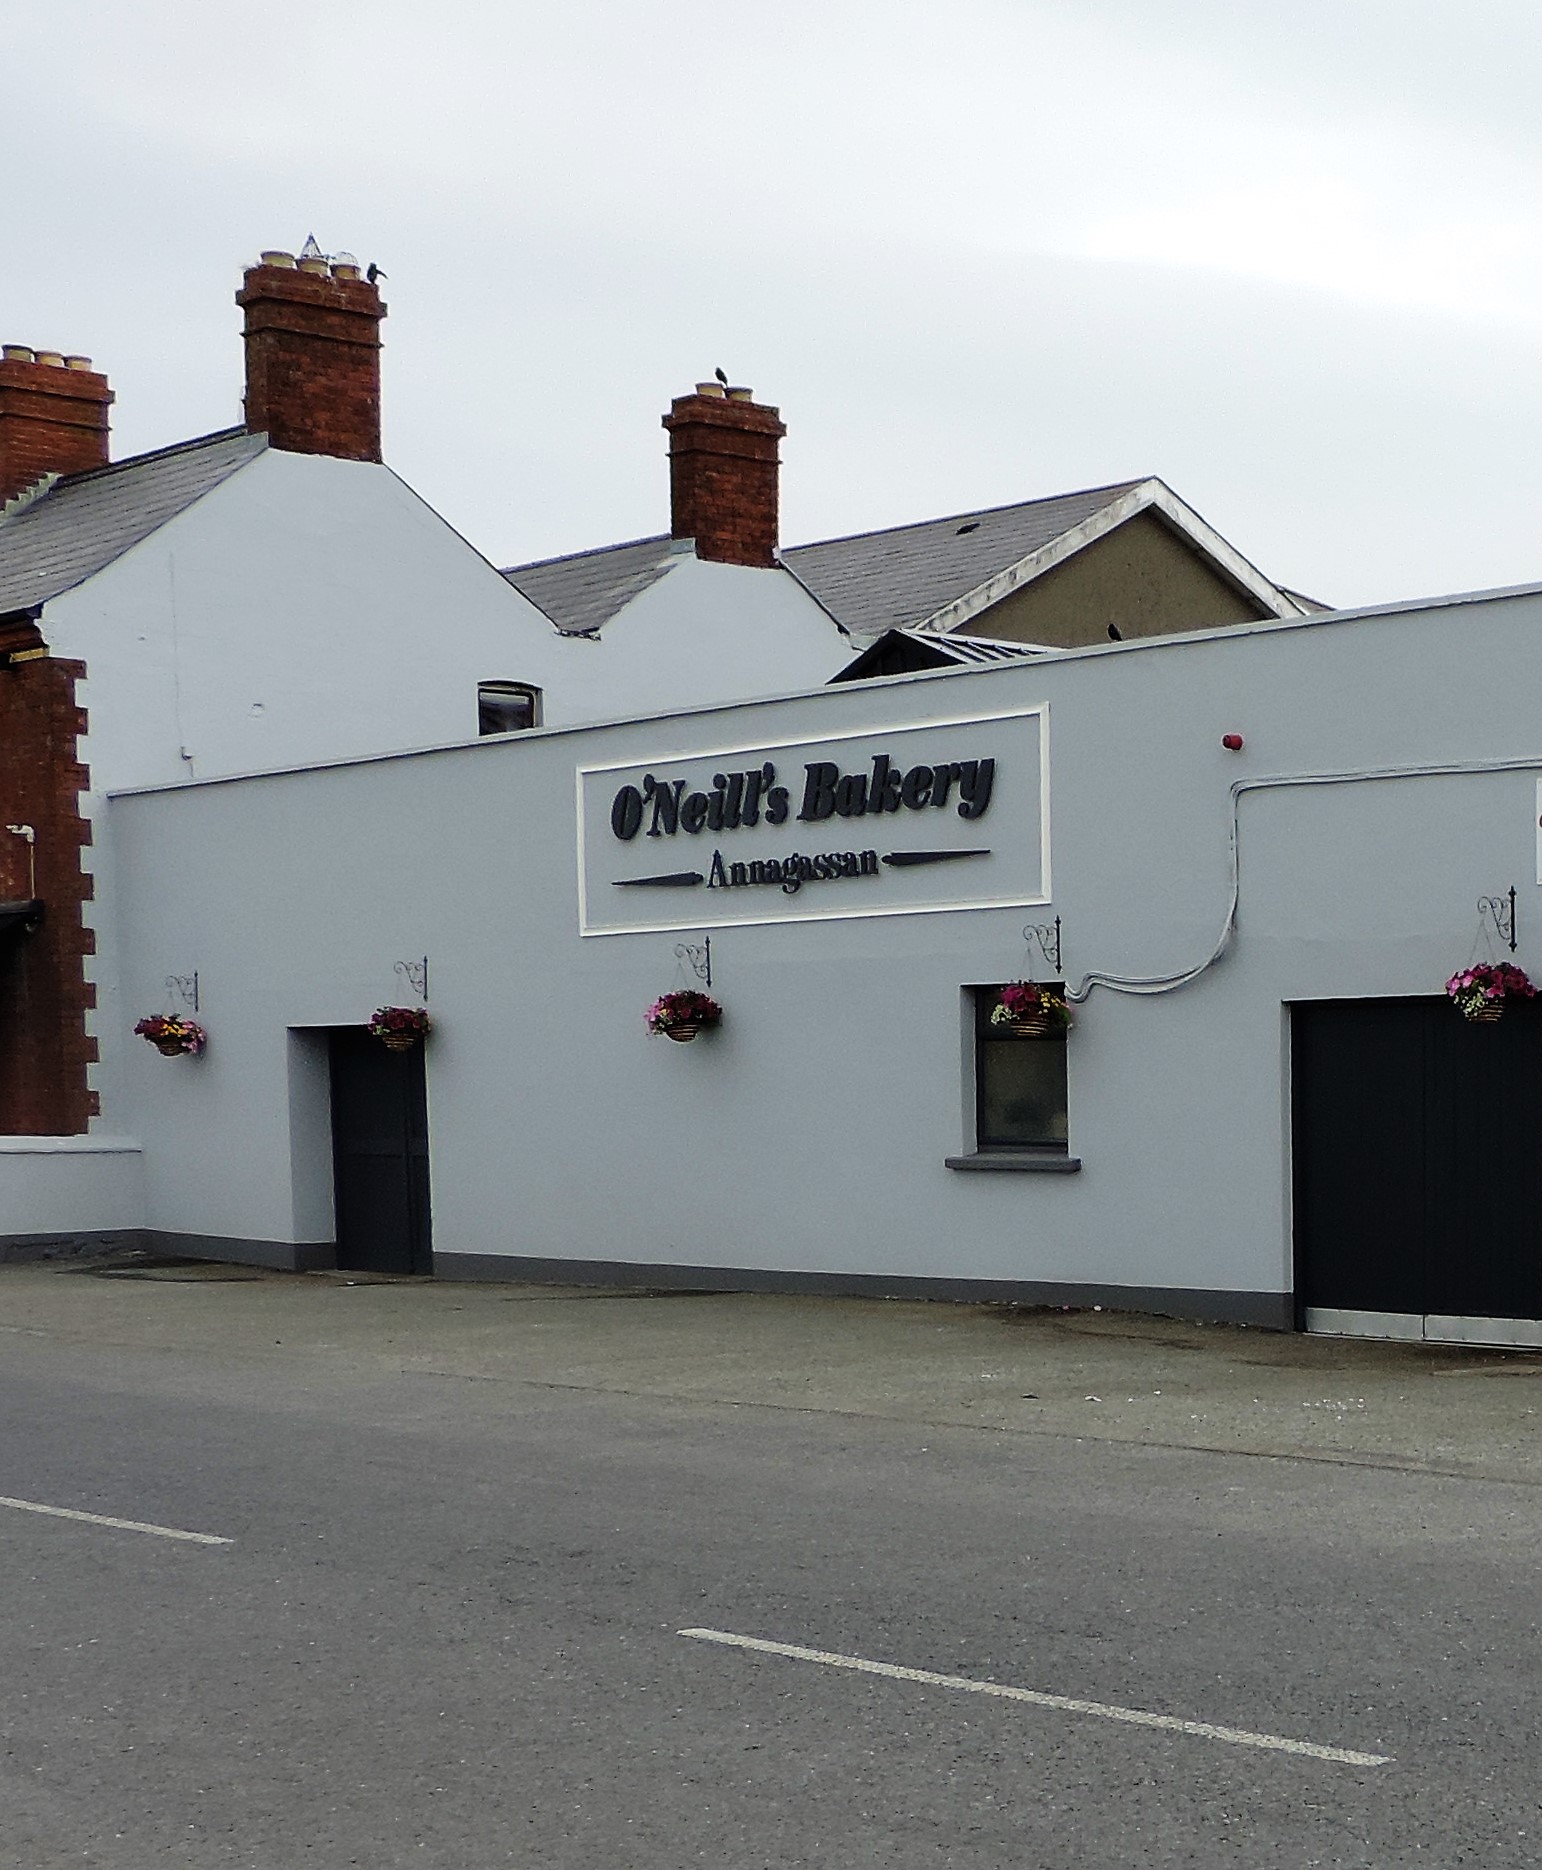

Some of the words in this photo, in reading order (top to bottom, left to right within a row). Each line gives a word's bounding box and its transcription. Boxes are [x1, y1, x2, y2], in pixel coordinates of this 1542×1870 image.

[611, 761, 790, 841] O'Neill's
[796, 753, 996, 821] Bakery
[706, 847, 879, 894] Annagassan
